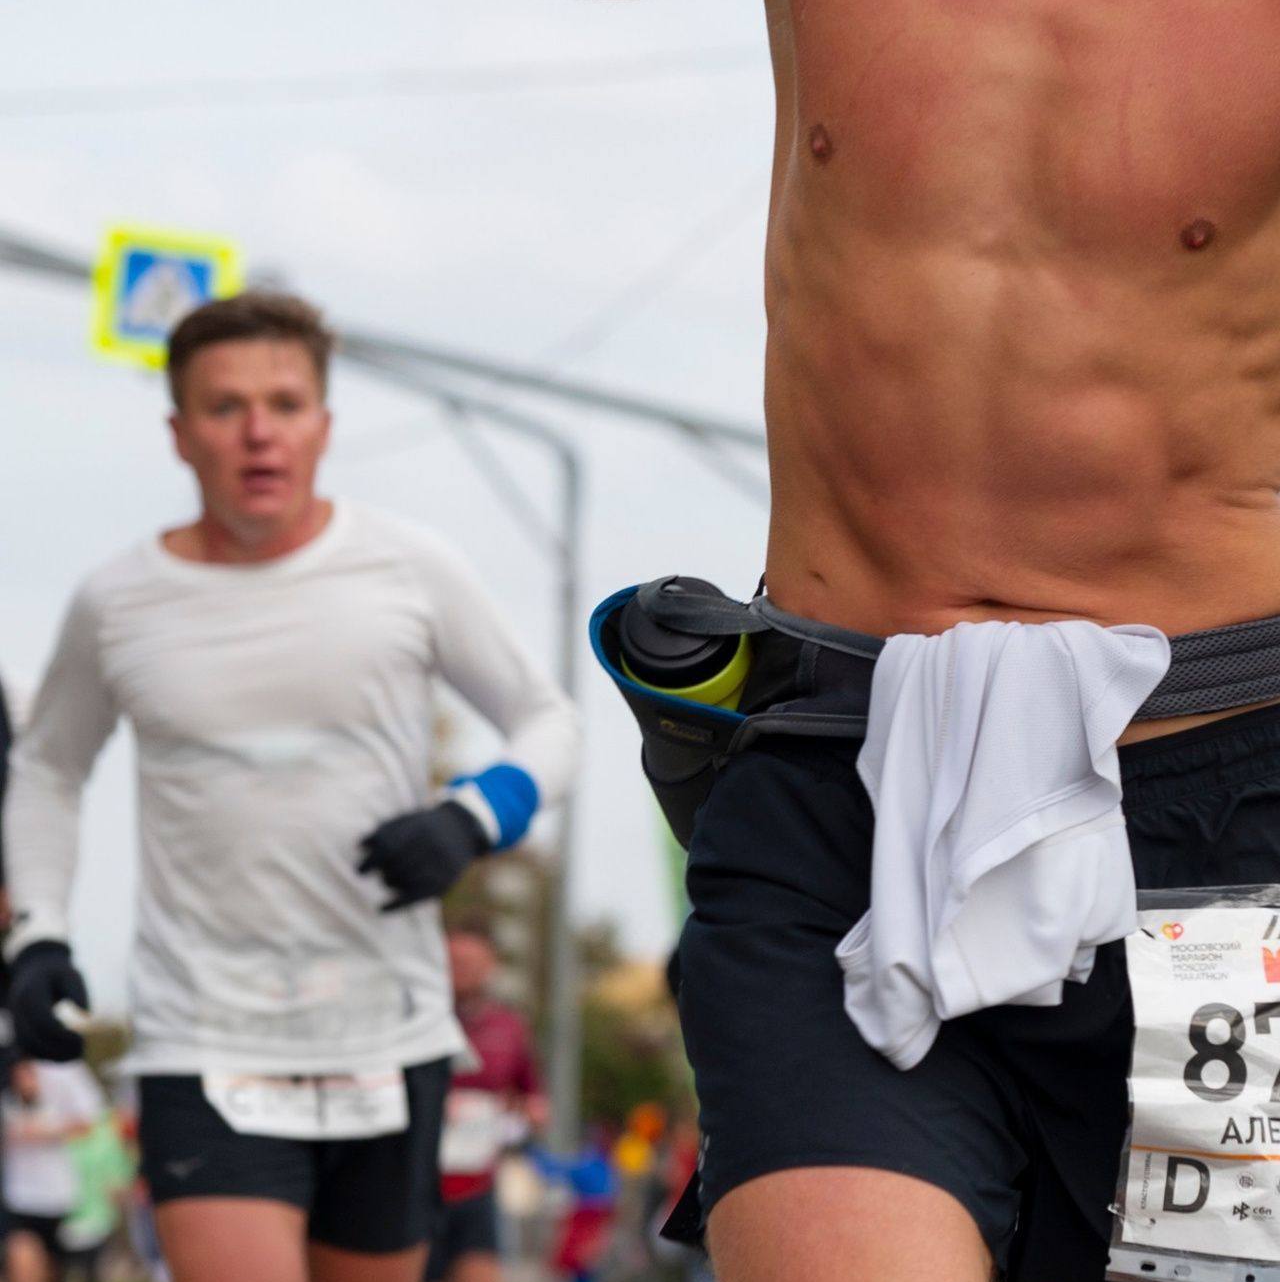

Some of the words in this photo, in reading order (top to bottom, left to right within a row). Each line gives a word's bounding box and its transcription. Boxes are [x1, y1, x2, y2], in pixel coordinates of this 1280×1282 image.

[1170, 941, 1242, 953] МОСКОВСКИЙ
[1171, 953, 1224, 962] МАРАФОН
[1172, 963, 1217, 972] MOSCOW
[1162, 1156, 1210, 1214] D
